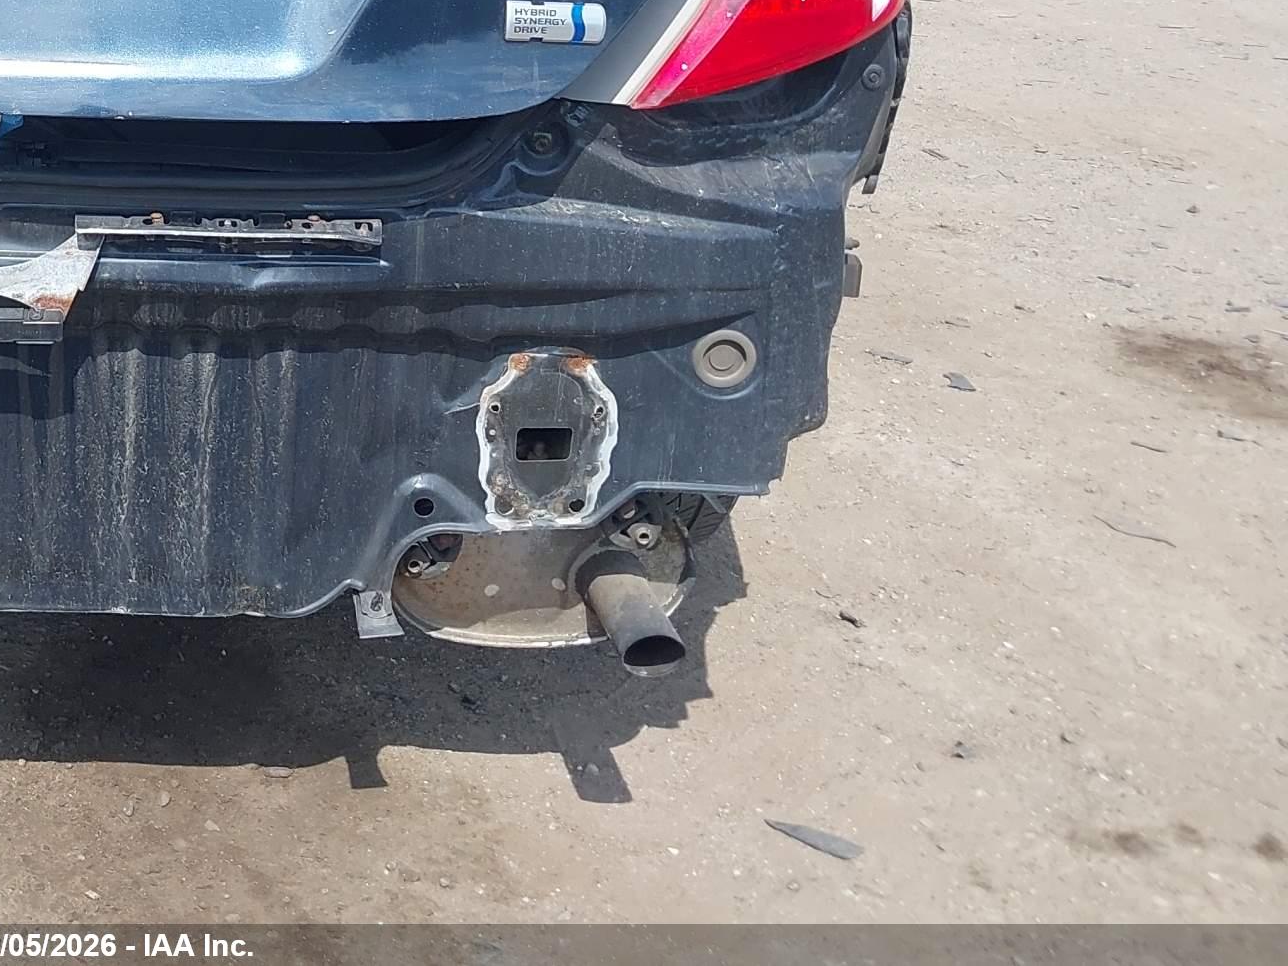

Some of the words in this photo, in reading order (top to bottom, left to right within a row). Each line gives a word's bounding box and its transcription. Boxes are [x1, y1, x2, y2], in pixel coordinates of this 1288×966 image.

[513, 7, 558, 18] HYBRID
[513, 17, 568, 27] SYNERGY
[513, 26, 548, 35] DRIVE
